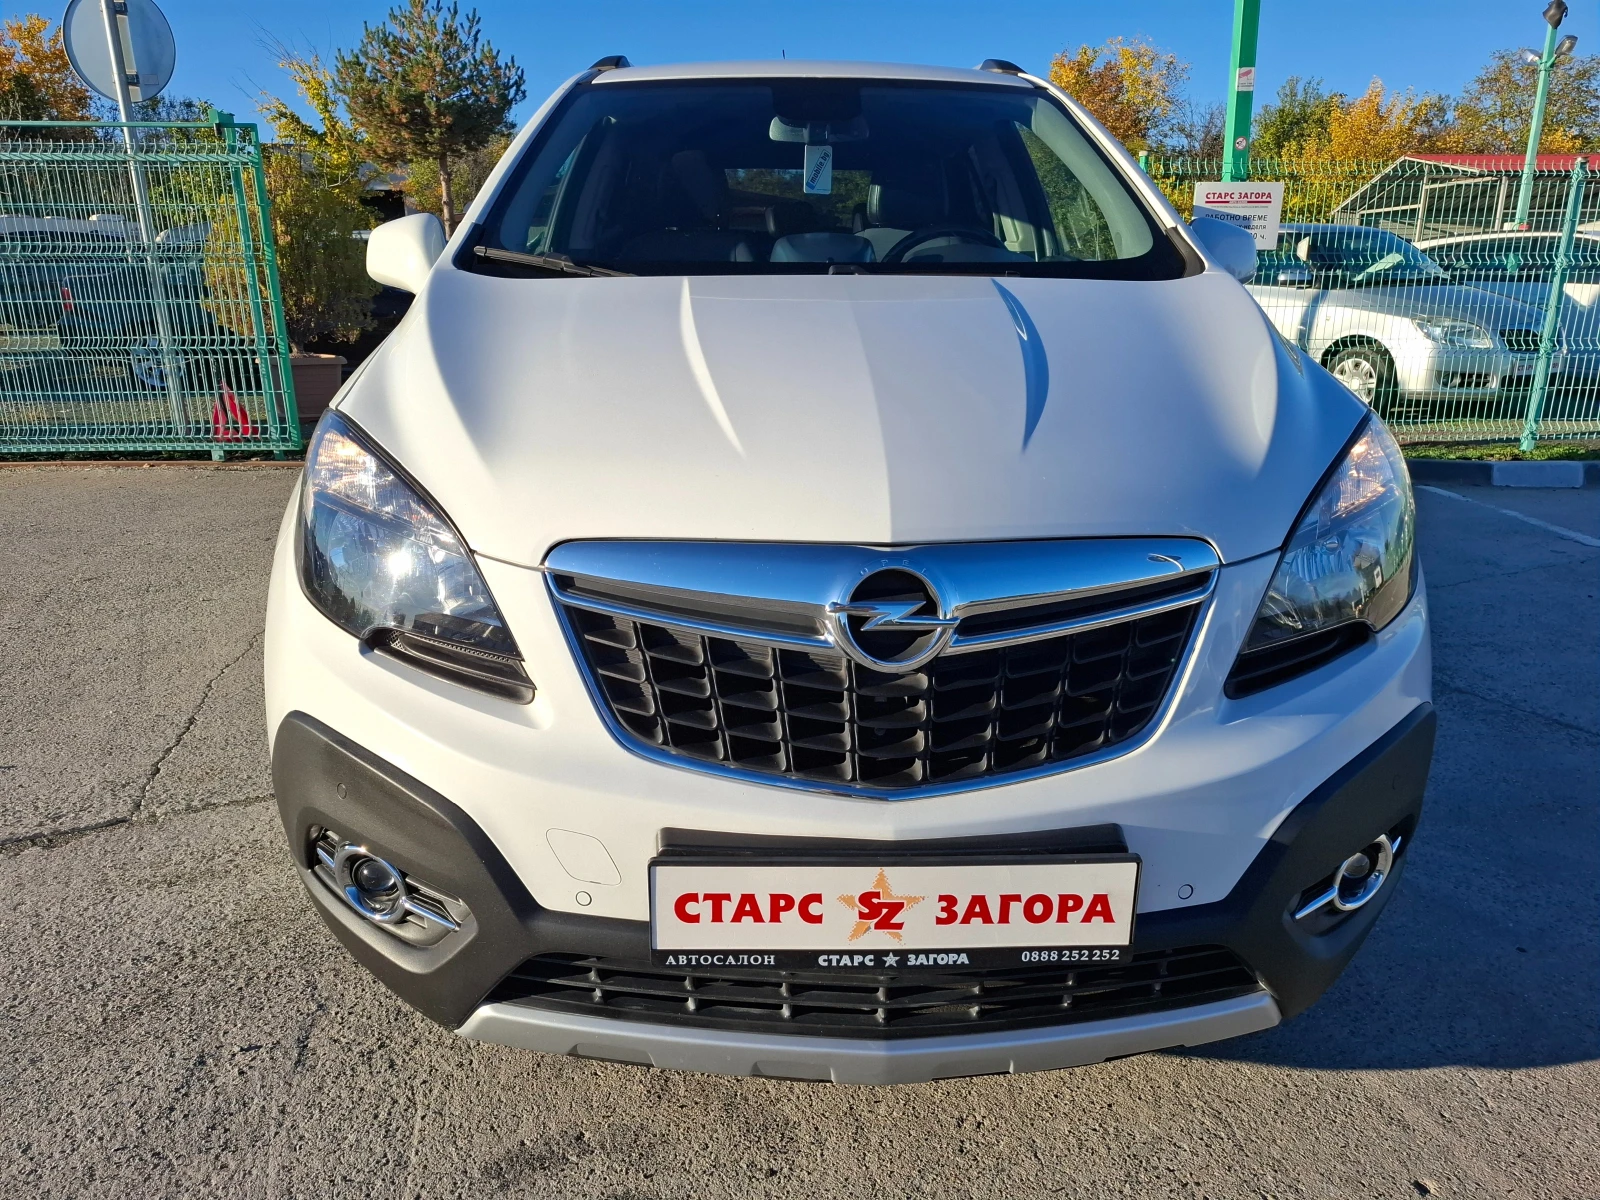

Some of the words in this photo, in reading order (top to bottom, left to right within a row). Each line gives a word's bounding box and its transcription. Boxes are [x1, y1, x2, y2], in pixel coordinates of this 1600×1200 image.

[810, 152, 830, 184] mobile.bg
[1242, 214, 1268, 222] ВРЕМЕ
[860, 559, 927, 576] OPEL
[673, 891, 824, 924] СТАРС
[858, 890, 905, 930] SZ
[935, 893, 1116, 925] ЗАГОРА
[665, 954, 776, 966] АВТОСАЛОН
[817, 954, 875, 967] СТАРС
[907, 953, 970, 966] ЗАГОРА
[1021, 950, 1058, 962] 0888
[1061, 950, 1089, 961] 252
[1092, 949, 1120, 960] 252
